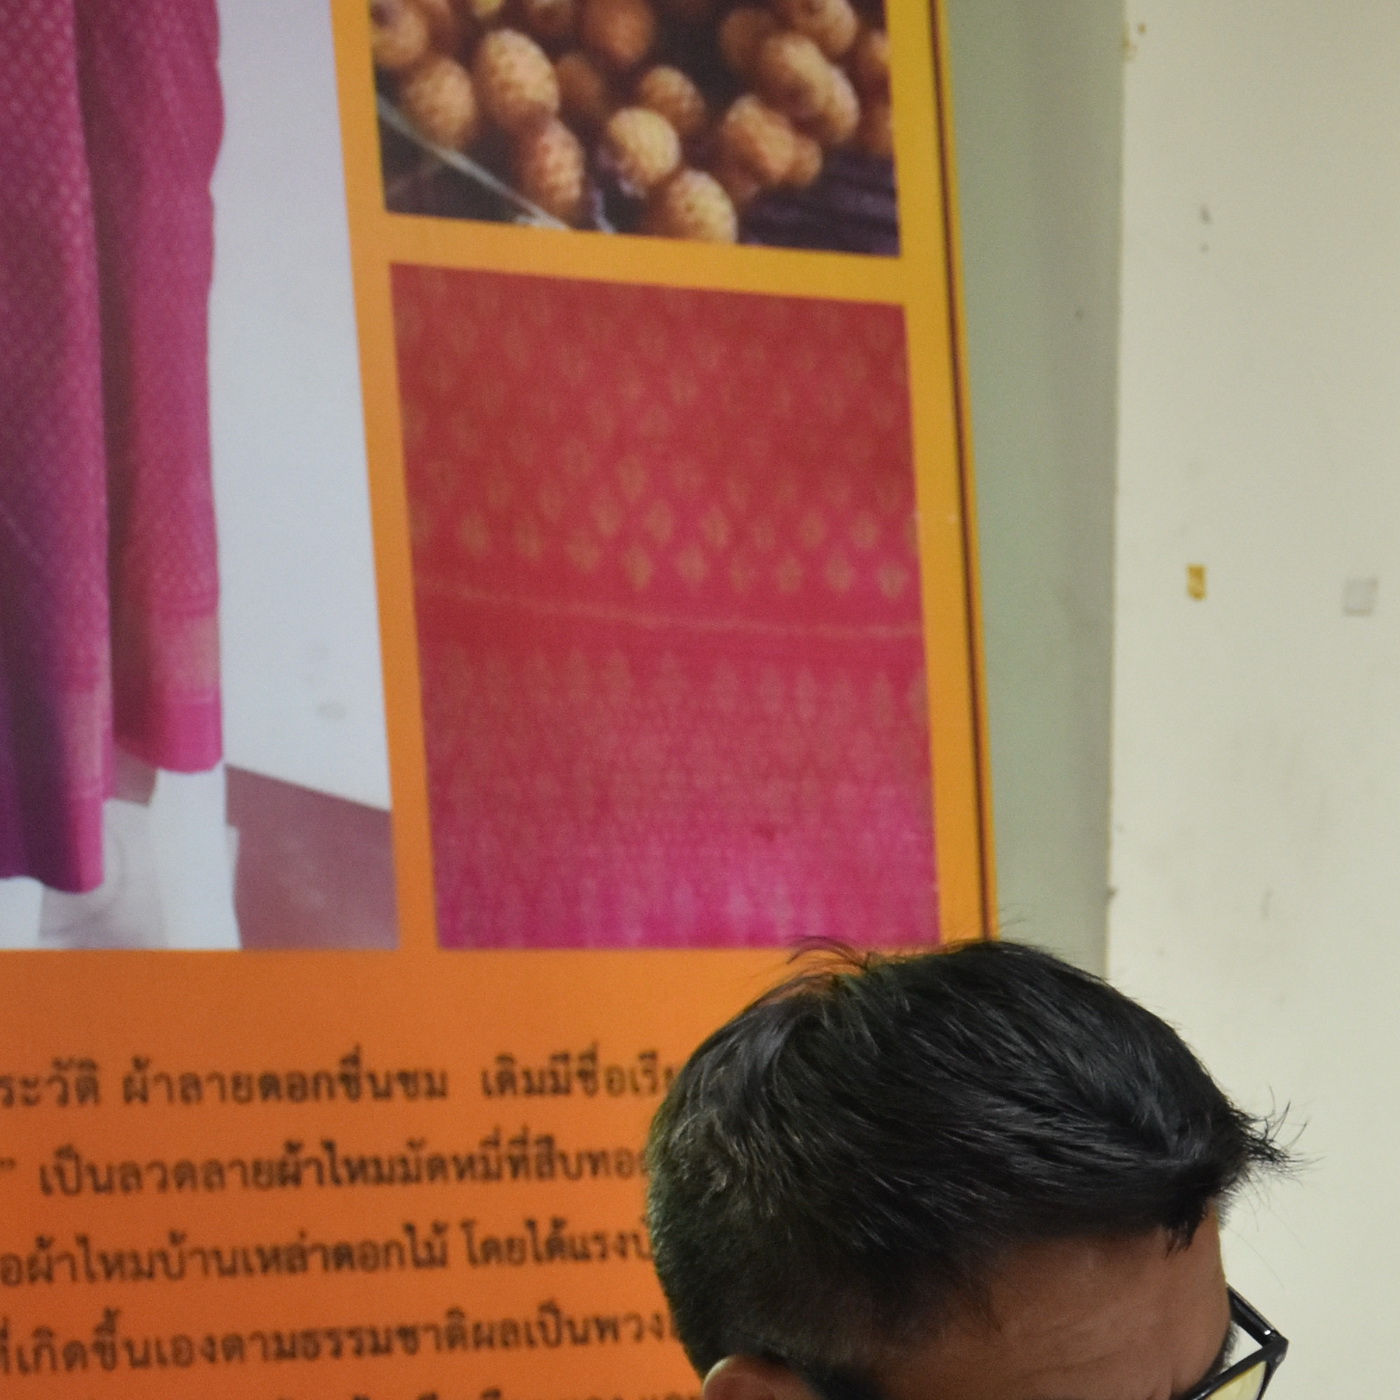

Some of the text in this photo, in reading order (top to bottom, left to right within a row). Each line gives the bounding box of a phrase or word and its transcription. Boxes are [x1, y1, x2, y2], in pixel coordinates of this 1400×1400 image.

[122, 1043, 448, 1104] ผ้าลายดอกชื่นชม
